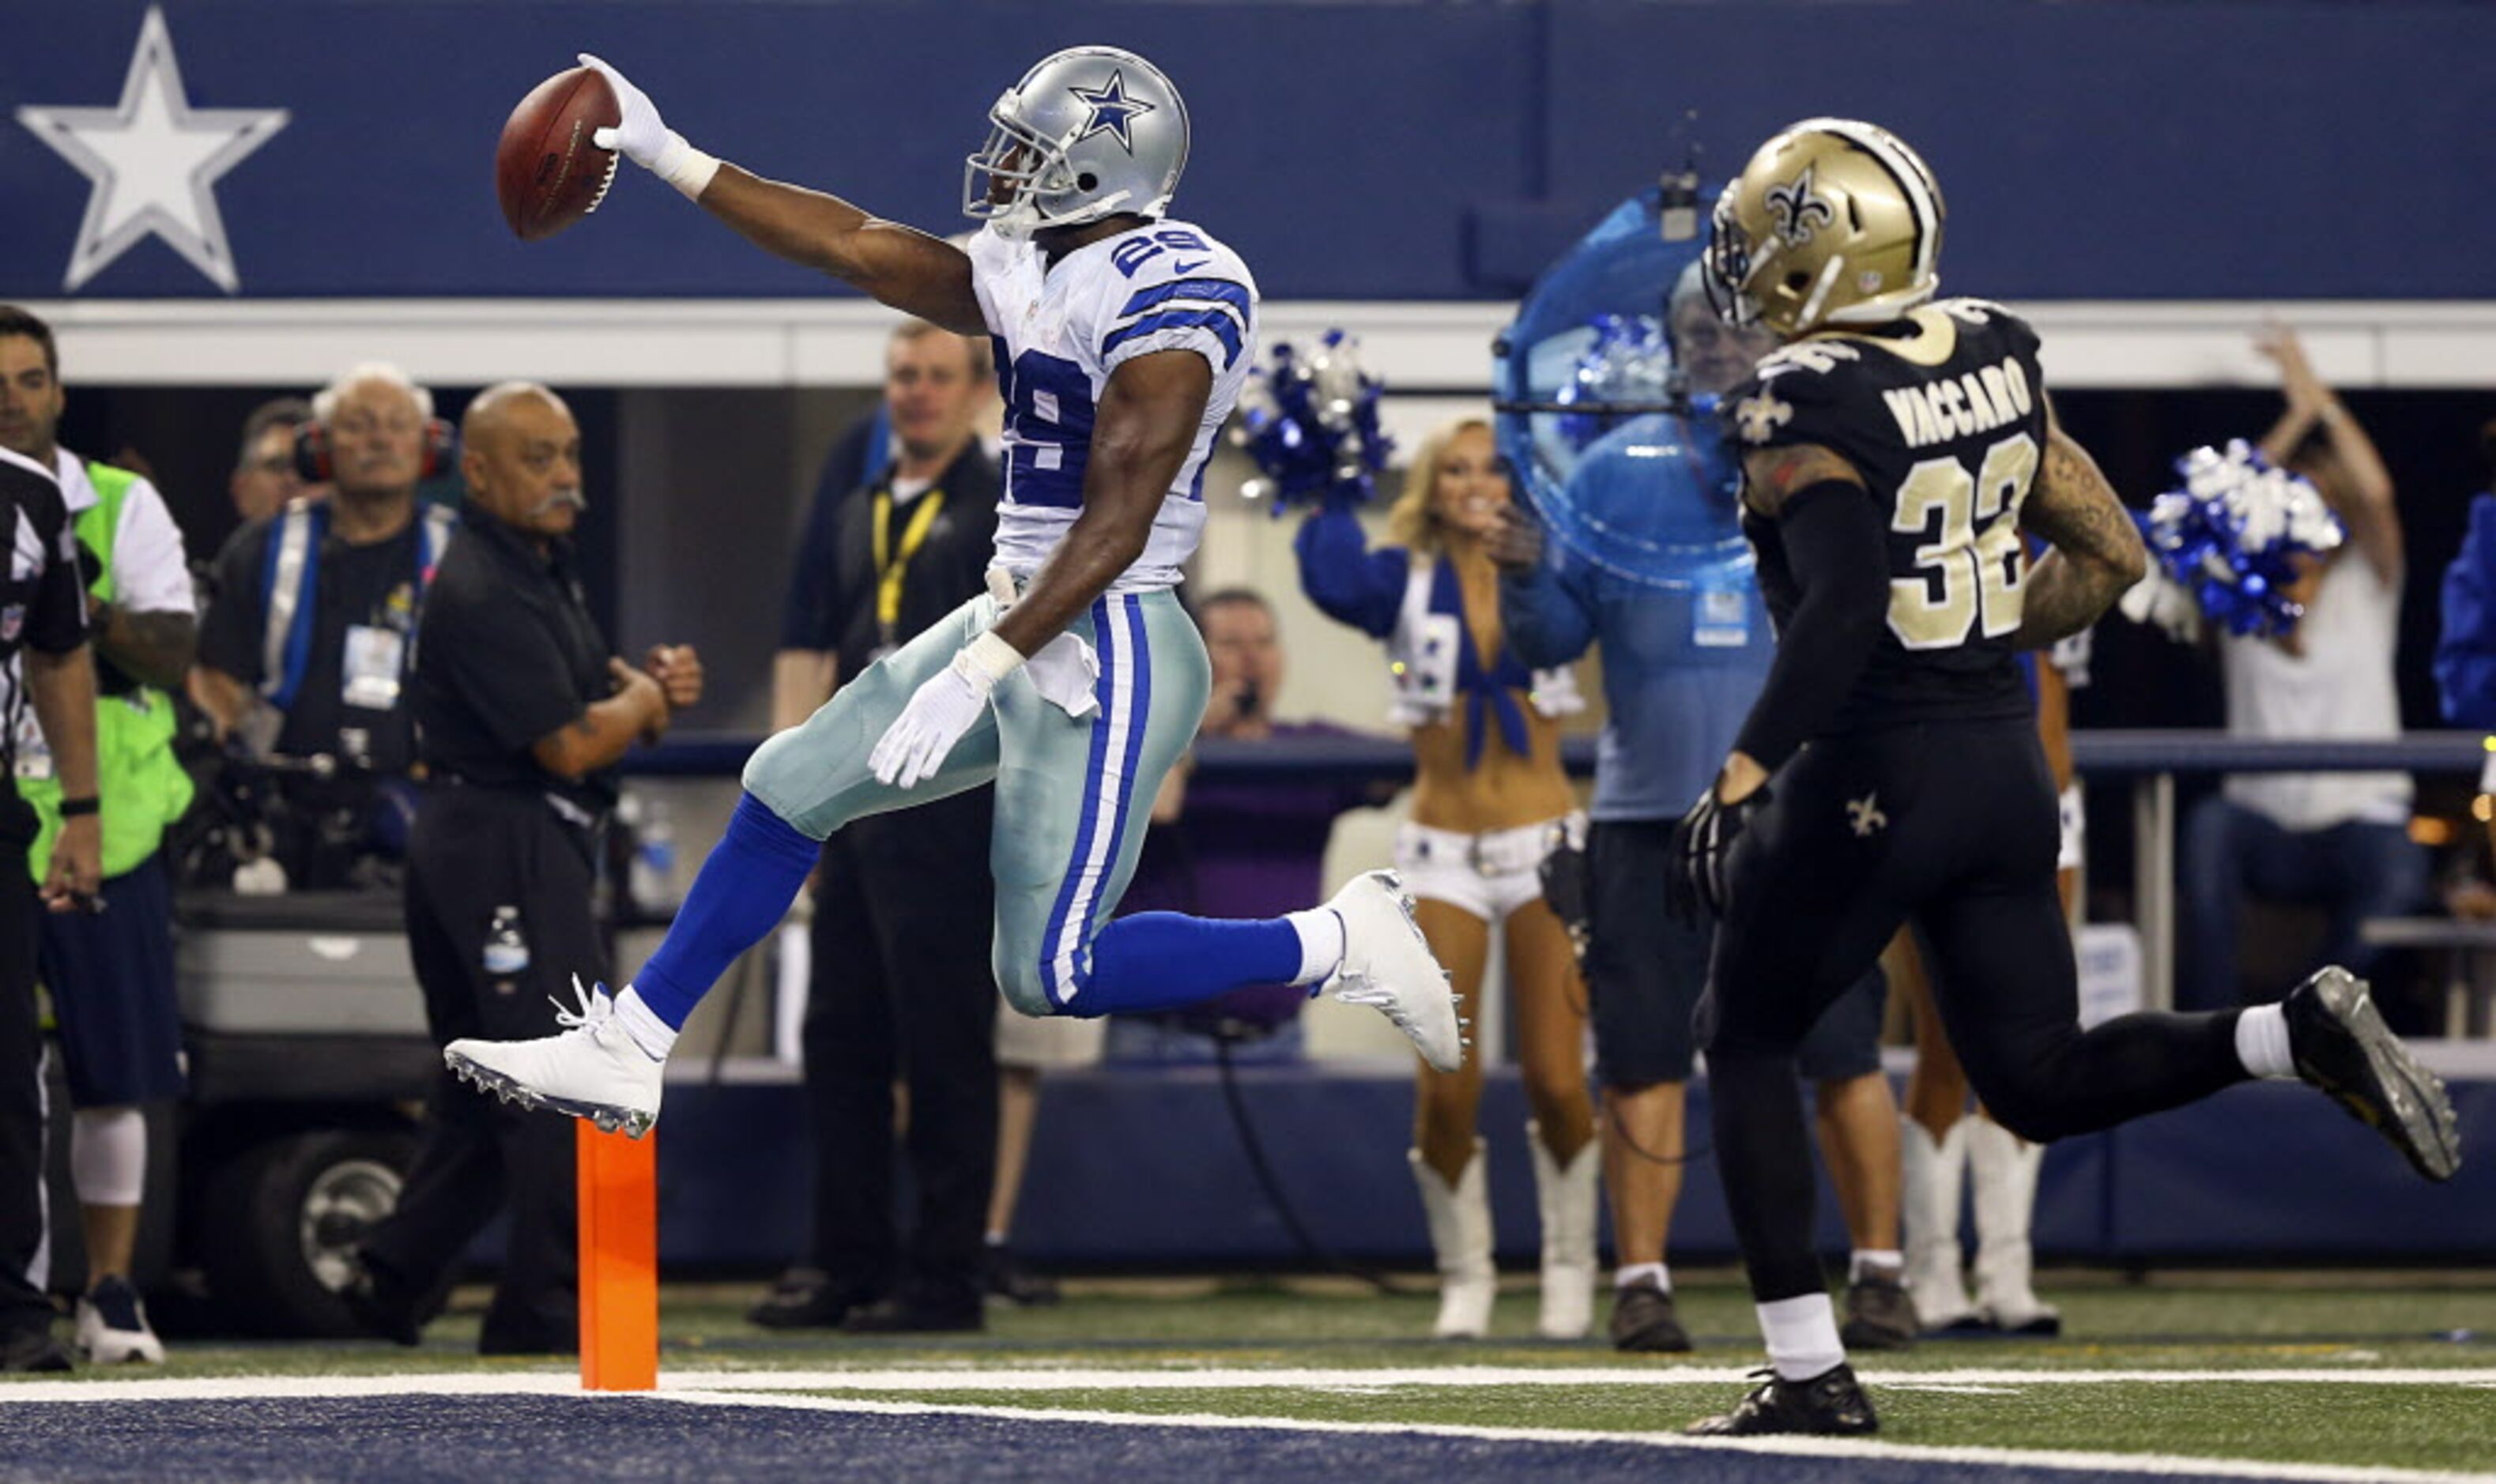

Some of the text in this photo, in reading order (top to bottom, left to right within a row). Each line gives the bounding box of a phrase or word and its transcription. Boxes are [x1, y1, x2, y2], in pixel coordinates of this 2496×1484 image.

[1111, 231, 1212, 279] 29
[1883, 356, 2032, 449] VACCARO
[1886, 431, 2038, 650] 32
